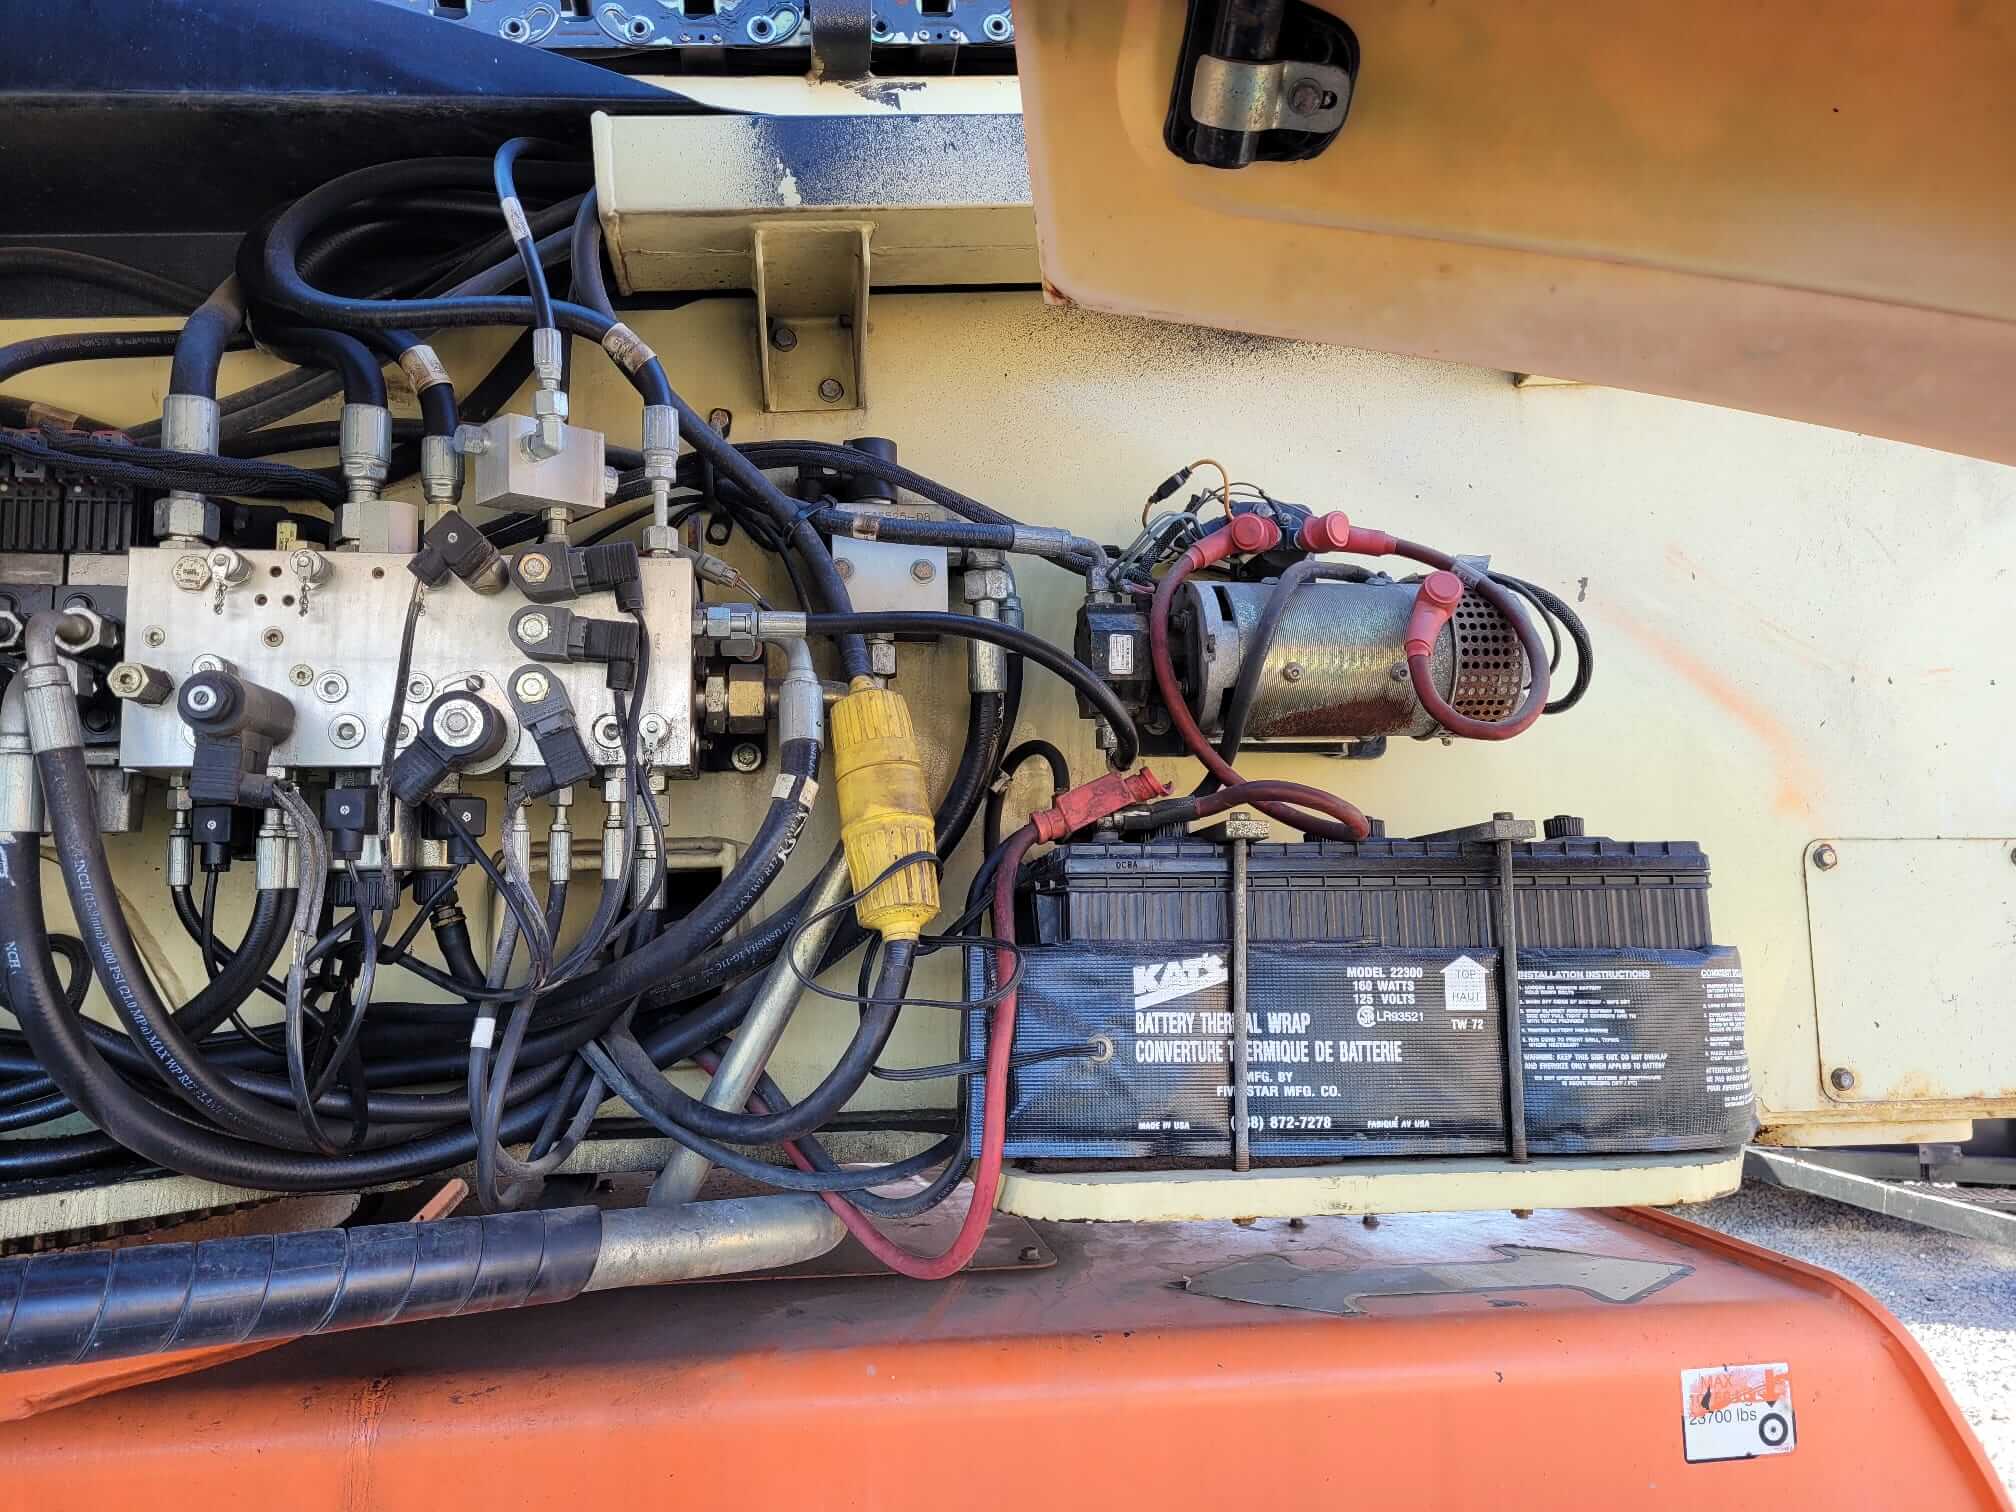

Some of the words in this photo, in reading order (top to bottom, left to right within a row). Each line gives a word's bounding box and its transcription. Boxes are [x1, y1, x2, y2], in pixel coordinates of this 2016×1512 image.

[99, 940, 118, 965] 3000
[108, 962, 129, 985] PSI
[1346, 966, 1386, 978] MODEL
[1390, 966, 1423, 978] 22300
[1455, 968, 1476, 979] TOP
[1517, 970, 1584, 980] INSTALLATION
[1585, 970, 1651, 979] INSTRUCTIONS
[1377, 980, 1415, 992] WATTS
[1352, 993, 1374, 1005] 125
[1381, 993, 1416, 1005] VOLTS
[1452, 991, 1481, 1002] HAUT
[1376, 1010, 1425, 1022] LR93521
[1135, 1011, 1195, 1034] BATTERY
[1200, 1011, 1263, 1034] THERAL
[1267, 1012, 1311, 1034] WRAP
[1450, 1018, 1468, 1031] TW
[1472, 1018, 1484, 1031] 72
[147, 1034, 171, 1062] MAX
[1135, 1040, 1224, 1063] CONVERTURE
[1227, 1040, 1309, 1064] TERMIQUE
[1314, 1041, 1334, 1063] DE
[1339, 1041, 1403, 1063] BATTERIE
[164, 1056, 184, 1075] WP
[1570, 1062, 1586, 1070] ONLY
[1587, 1062, 1607, 1070] WHEN
[1632, 1062, 1641, 1070] TO
[1277, 1071, 1293, 1083] BY
[1216, 1085, 1236, 1097] FIV
[1246, 1085, 1279, 1097] STAR
[1283, 1085, 1316, 1097] MFG.
[1320, 1085, 1342, 1097] CO.
[1138, 1121, 1161, 1130] MADE
[1162, 1121, 1171, 1130] IN
[1173, 1121, 1190, 1130] USA
[1269, 1115, 1332, 1129] 872-7278
[1414, 1119, 1430, 1129] USA
[1736, 1408, 1757, 1423] lbs
